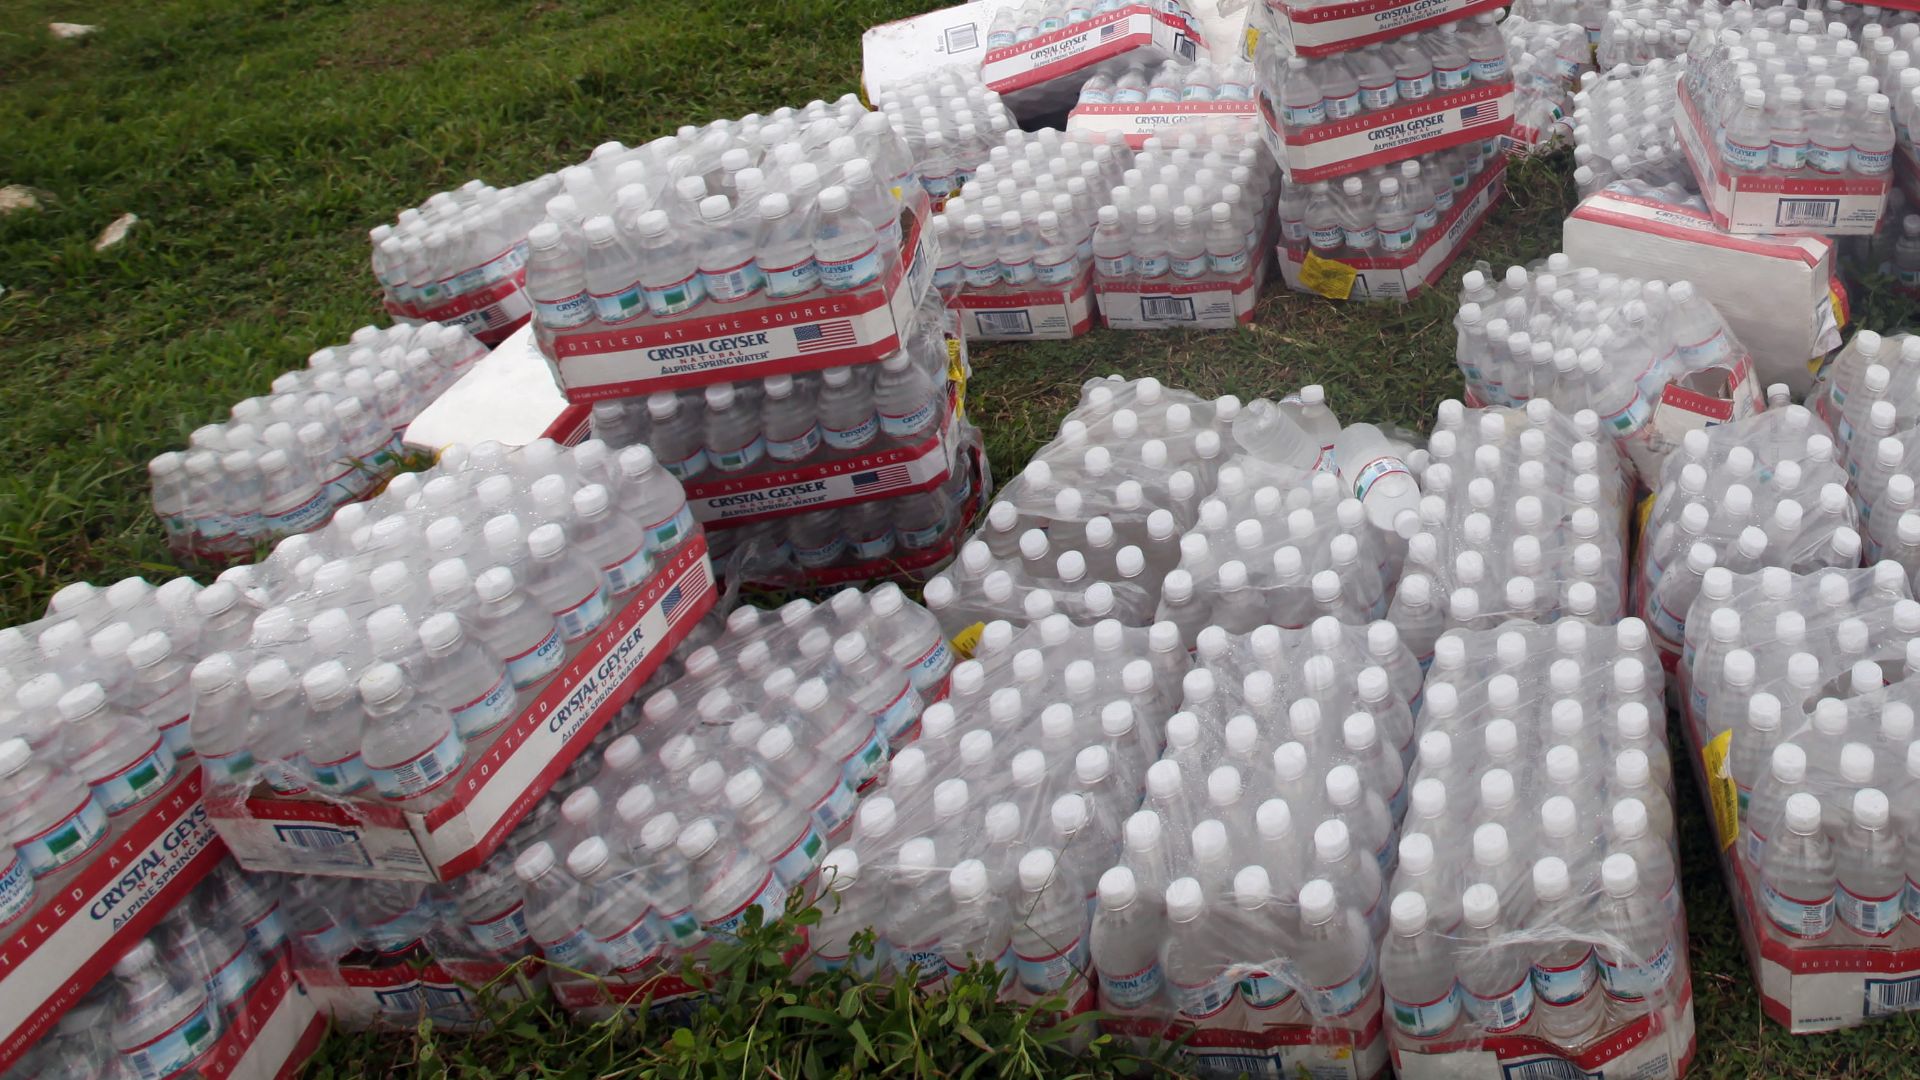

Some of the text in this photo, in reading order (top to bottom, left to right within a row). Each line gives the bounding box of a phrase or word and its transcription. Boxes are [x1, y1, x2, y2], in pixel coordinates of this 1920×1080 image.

[1313, 5, 1375, 19] BOTTLED
[1374, 5, 1414, 22] CRYSTAL
[1379, 7, 1448, 31] ALPINE SPRING WATER
[988, 42, 1034, 61] BOTTLED
[1062, 26, 1079, 37] THE
[1030, 33, 1089, 61] CRYSTAL GEYSER
[1135, 116, 1170, 125] CRYSTAL
[1309, 90, 1493, 139] BOTTLED AT THE SOURCE
[1368, 114, 1445, 141] CRYSTAL GEYSER
[1373, 129, 1442, 151] ALPINE SPRING WATER
[559, 304, 840, 352] OTTLED AT THE SOURCE
[648, 332, 769, 361] CRYSTAL GEYSER
[680, 350, 744, 364] NATURAL
[661, 351, 769, 375] ALPINE SPRING WATER
[765, 473, 800, 484] THE
[820, 453, 897, 475] SOURCE
[708, 491, 766, 509] CRYSTAL
[768, 480, 827, 498] GEYSER
[720, 495, 827, 518] ALPINE SPRING WATER
[468, 702, 548, 791] BOTTLED
[563, 667, 581, 688] AT
[596, 621, 626, 652] THE
[638, 548, 695, 610] SOURCE
[549, 626, 644, 733] CRYSTAL GEYSER
[562, 650, 644, 743] ALPINE SPRING WATER
[579, 659, 628, 712] NATURAL
[109, 841, 134, 868] AT
[157, 782, 200, 821] THE
[90, 804, 208, 920] CRYSTAL GEYS
[137, 820, 209, 891] NATURAL
[113, 887, 157, 931] ALPINE
[155, 845, 198, 889] SPRING
[1802, 961, 1872, 969] BOTTLED
[216, 971, 289, 1073] BOTTLED
